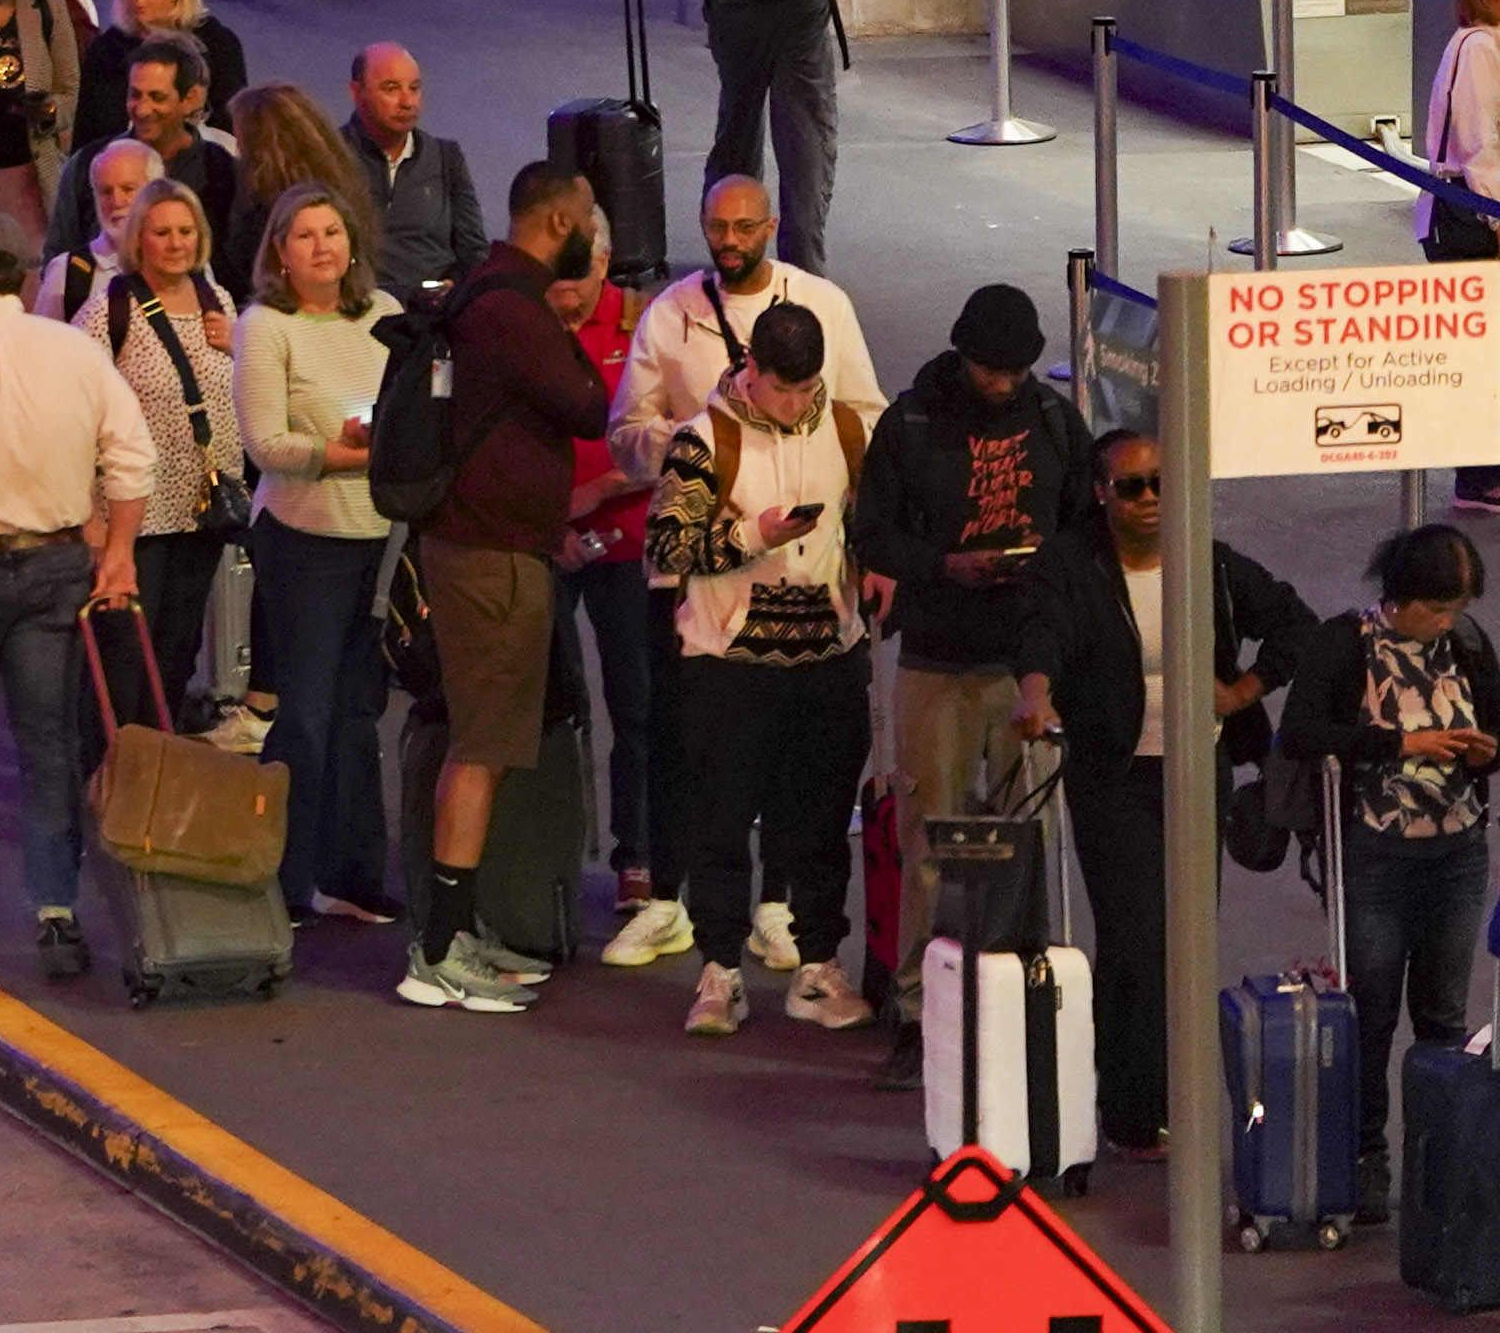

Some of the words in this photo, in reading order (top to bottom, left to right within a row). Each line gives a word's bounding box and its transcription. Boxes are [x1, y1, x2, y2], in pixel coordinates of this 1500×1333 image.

[1229, 285, 1284, 313] NO
[1297, 276, 1486, 310] STOPPING
[1228, 321, 1281, 349] OR
[1294, 310, 1488, 346] STANDING
[1269, 353, 1339, 373] Except
[1347, 352, 1374, 369] for
[1382, 350, 1448, 367] Active
[1254, 375, 1337, 395] Loading
[1342, 373, 1353, 391] /
[1360, 370, 1463, 390] Unloading
